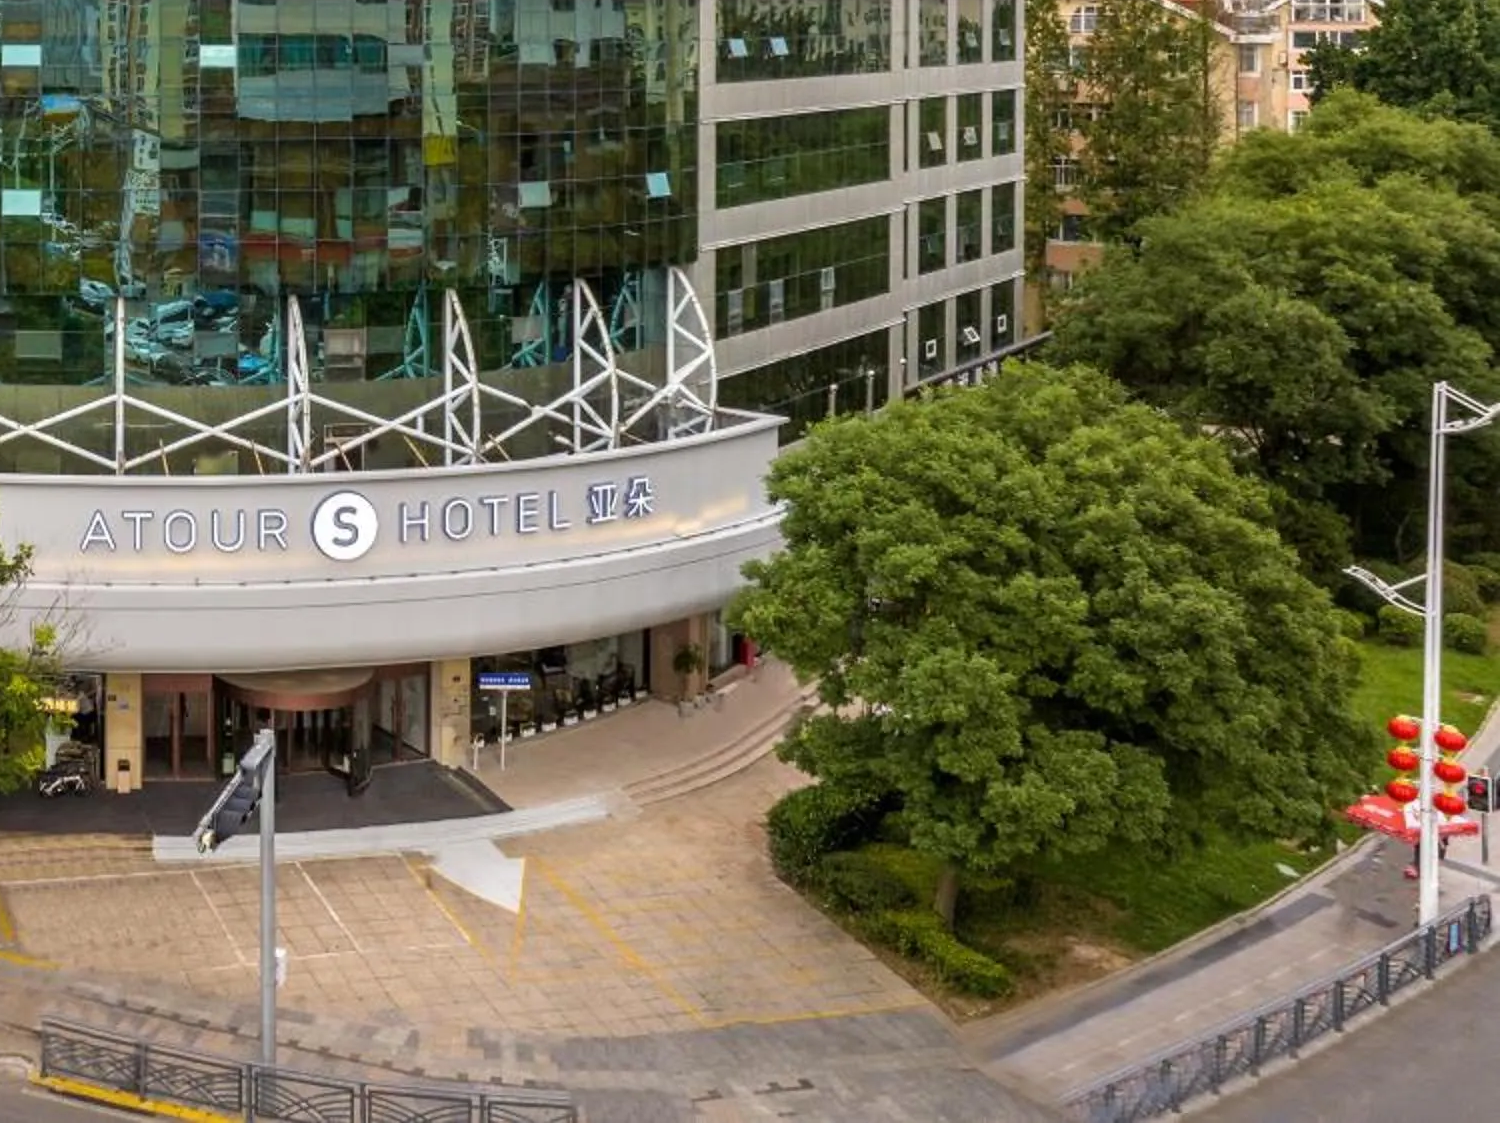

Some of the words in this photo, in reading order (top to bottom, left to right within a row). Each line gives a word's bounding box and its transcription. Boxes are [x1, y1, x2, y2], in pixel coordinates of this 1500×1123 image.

[79, 509, 288, 554] ATOUR
[400, 490, 573, 543] HOTEL
[587, 475, 655, 525] 亚朵
